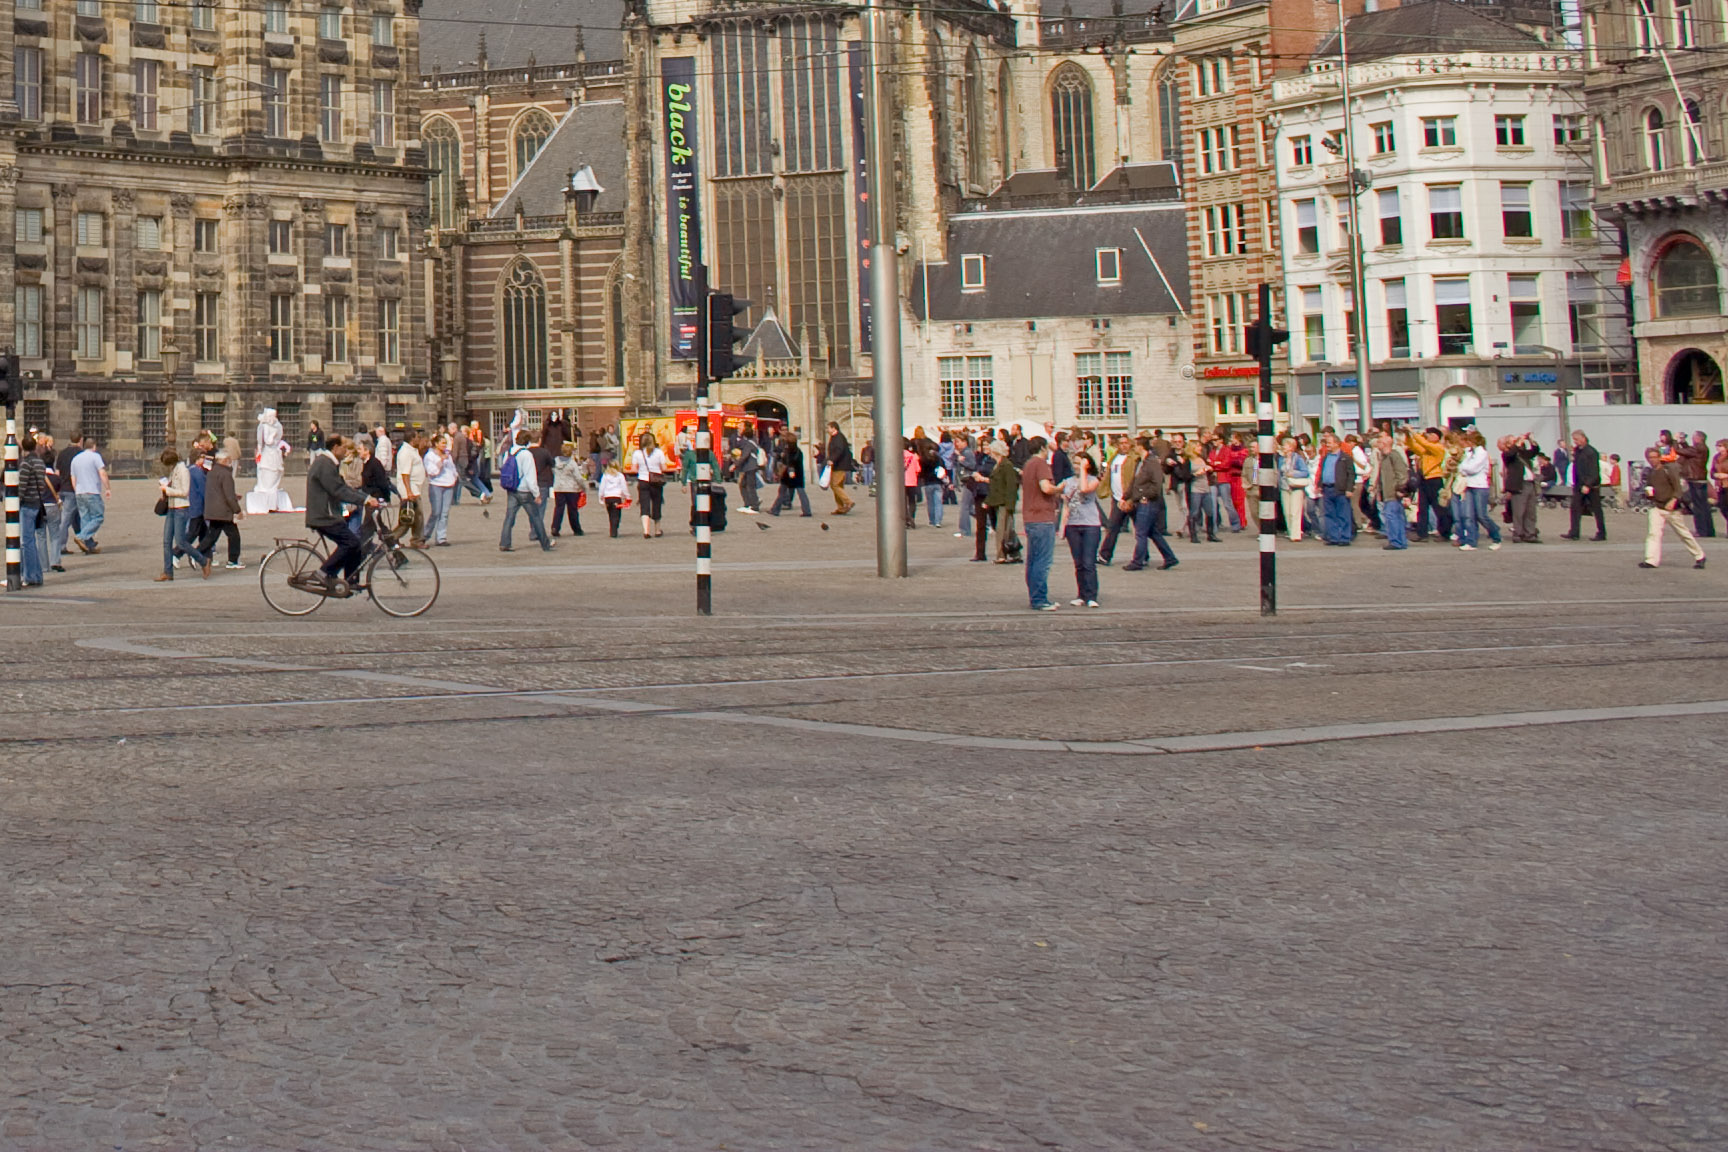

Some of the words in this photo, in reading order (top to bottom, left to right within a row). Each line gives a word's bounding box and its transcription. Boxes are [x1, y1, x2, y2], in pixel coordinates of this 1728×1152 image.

[667, 83, 694, 166] black
[678, 196, 690, 210] is
[677, 213, 693, 281] beautiful
